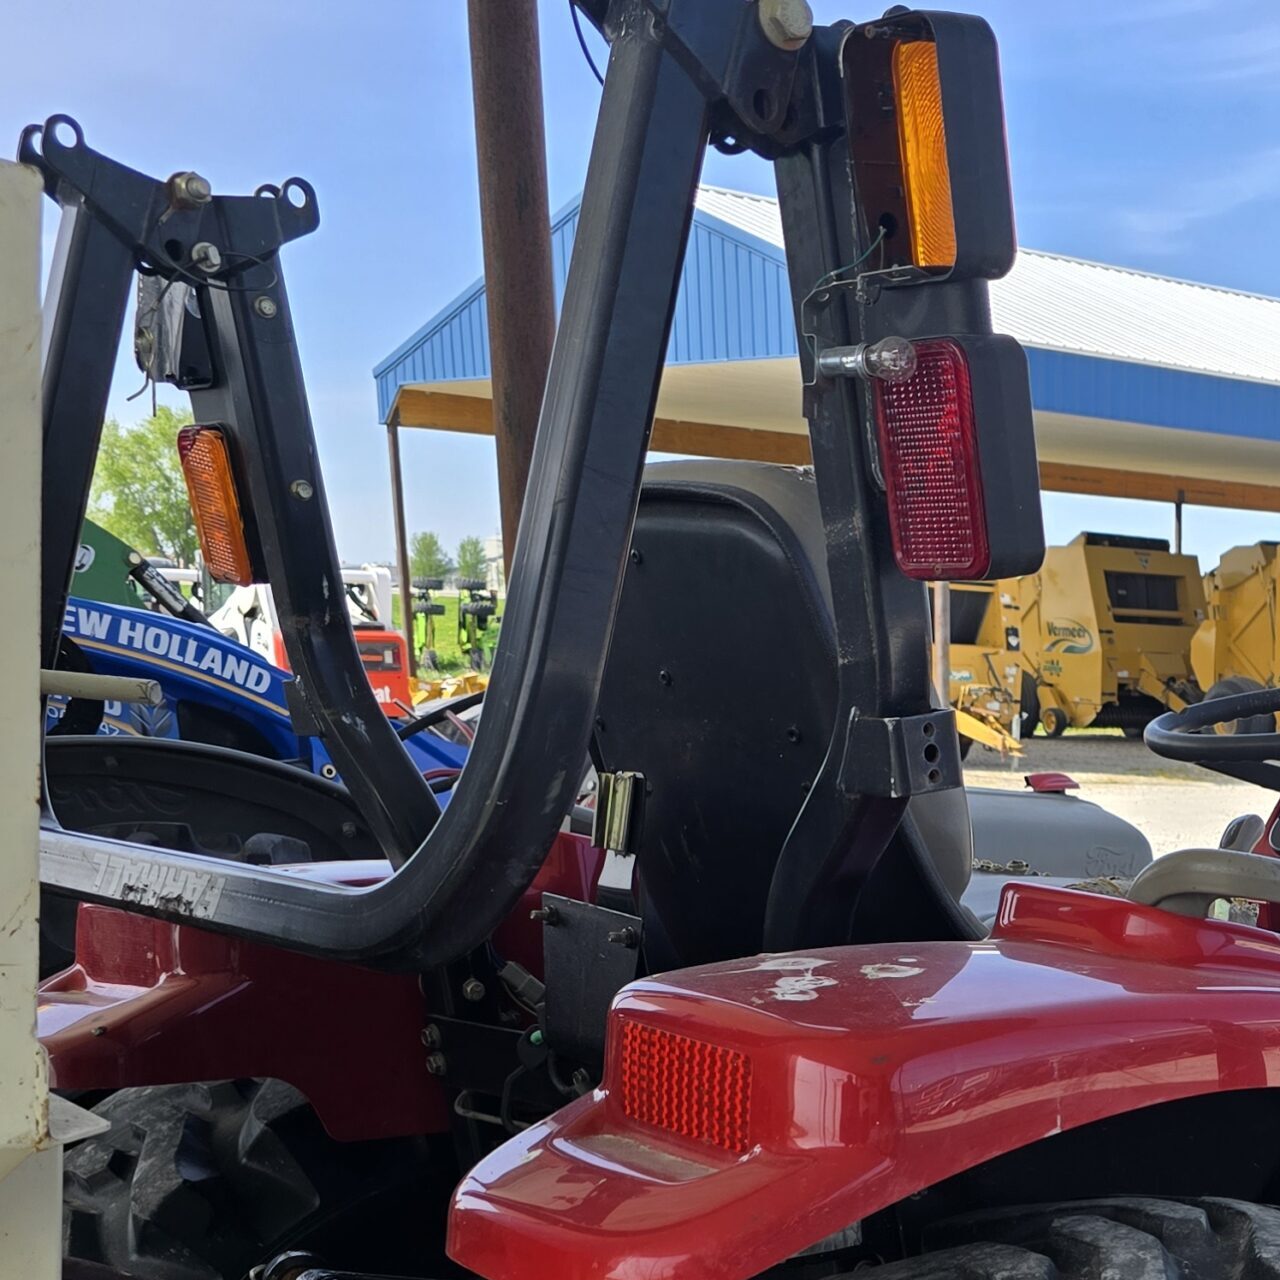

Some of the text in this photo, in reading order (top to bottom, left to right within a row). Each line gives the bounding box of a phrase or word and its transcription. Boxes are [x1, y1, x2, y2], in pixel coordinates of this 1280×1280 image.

[62, 606, 272, 694] EW HOLLAND
[1046, 621, 1087, 639] Vermeer
